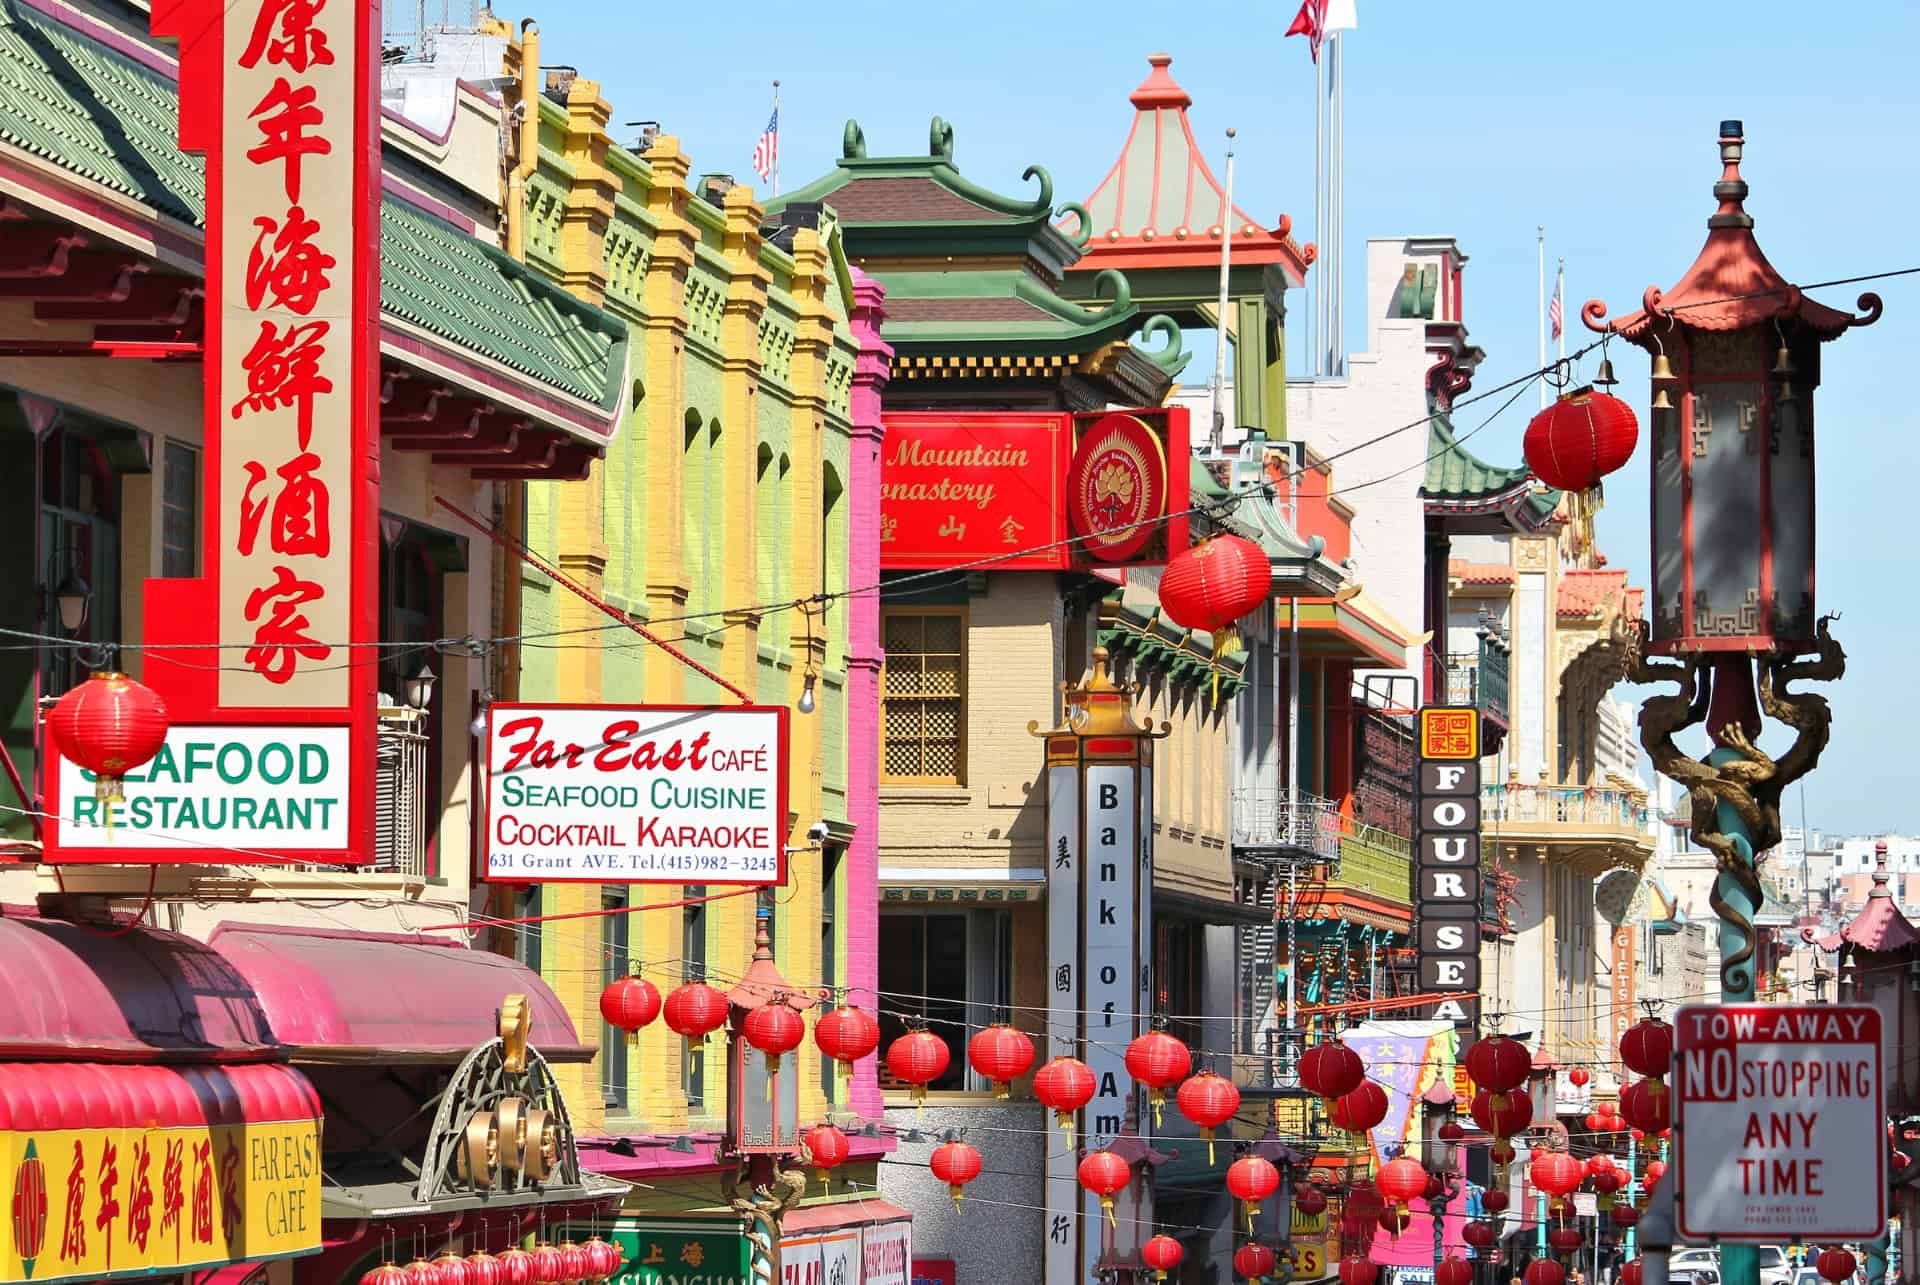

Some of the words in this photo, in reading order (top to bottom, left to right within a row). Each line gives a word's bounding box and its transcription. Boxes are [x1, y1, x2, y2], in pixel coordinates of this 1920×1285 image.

[886, 439, 1029, 467] Mountain
[79, 742, 329, 785] AFOOD
[499, 716, 584, 773] Far
[594, 720, 710, 772] East
[712, 744, 768, 772] CAFÉ
[502, 775, 638, 808] SEAFOOD
[651, 777, 766, 810] CUISINE
[73, 796, 338, 830] RESTAURANT
[497, 815, 626, 847] COCKTAIL
[637, 816, 769, 849] KARAOKE
[1433, 766, 1468, 898] FOUR
[490, 854, 514, 868] 631
[522, 854, 572, 869] Grant
[582, 855, 623, 870] AVE.
[1099, 784, 1119, 925] Bank
[1100, 966, 1117, 1027] of
[1692, 1014, 1865, 1041] TOW-AWAY
[1686, 1048, 1733, 1099] NO
[1742, 1061, 1870, 1099] STOPPING
[1744, 1111, 1817, 1149] ANY
[252, 1136, 280, 1182] FAR
[284, 1133, 321, 1180] EAST
[1737, 1159, 1824, 1197] TIME
[265, 1181, 308, 1238] CAFÉ
